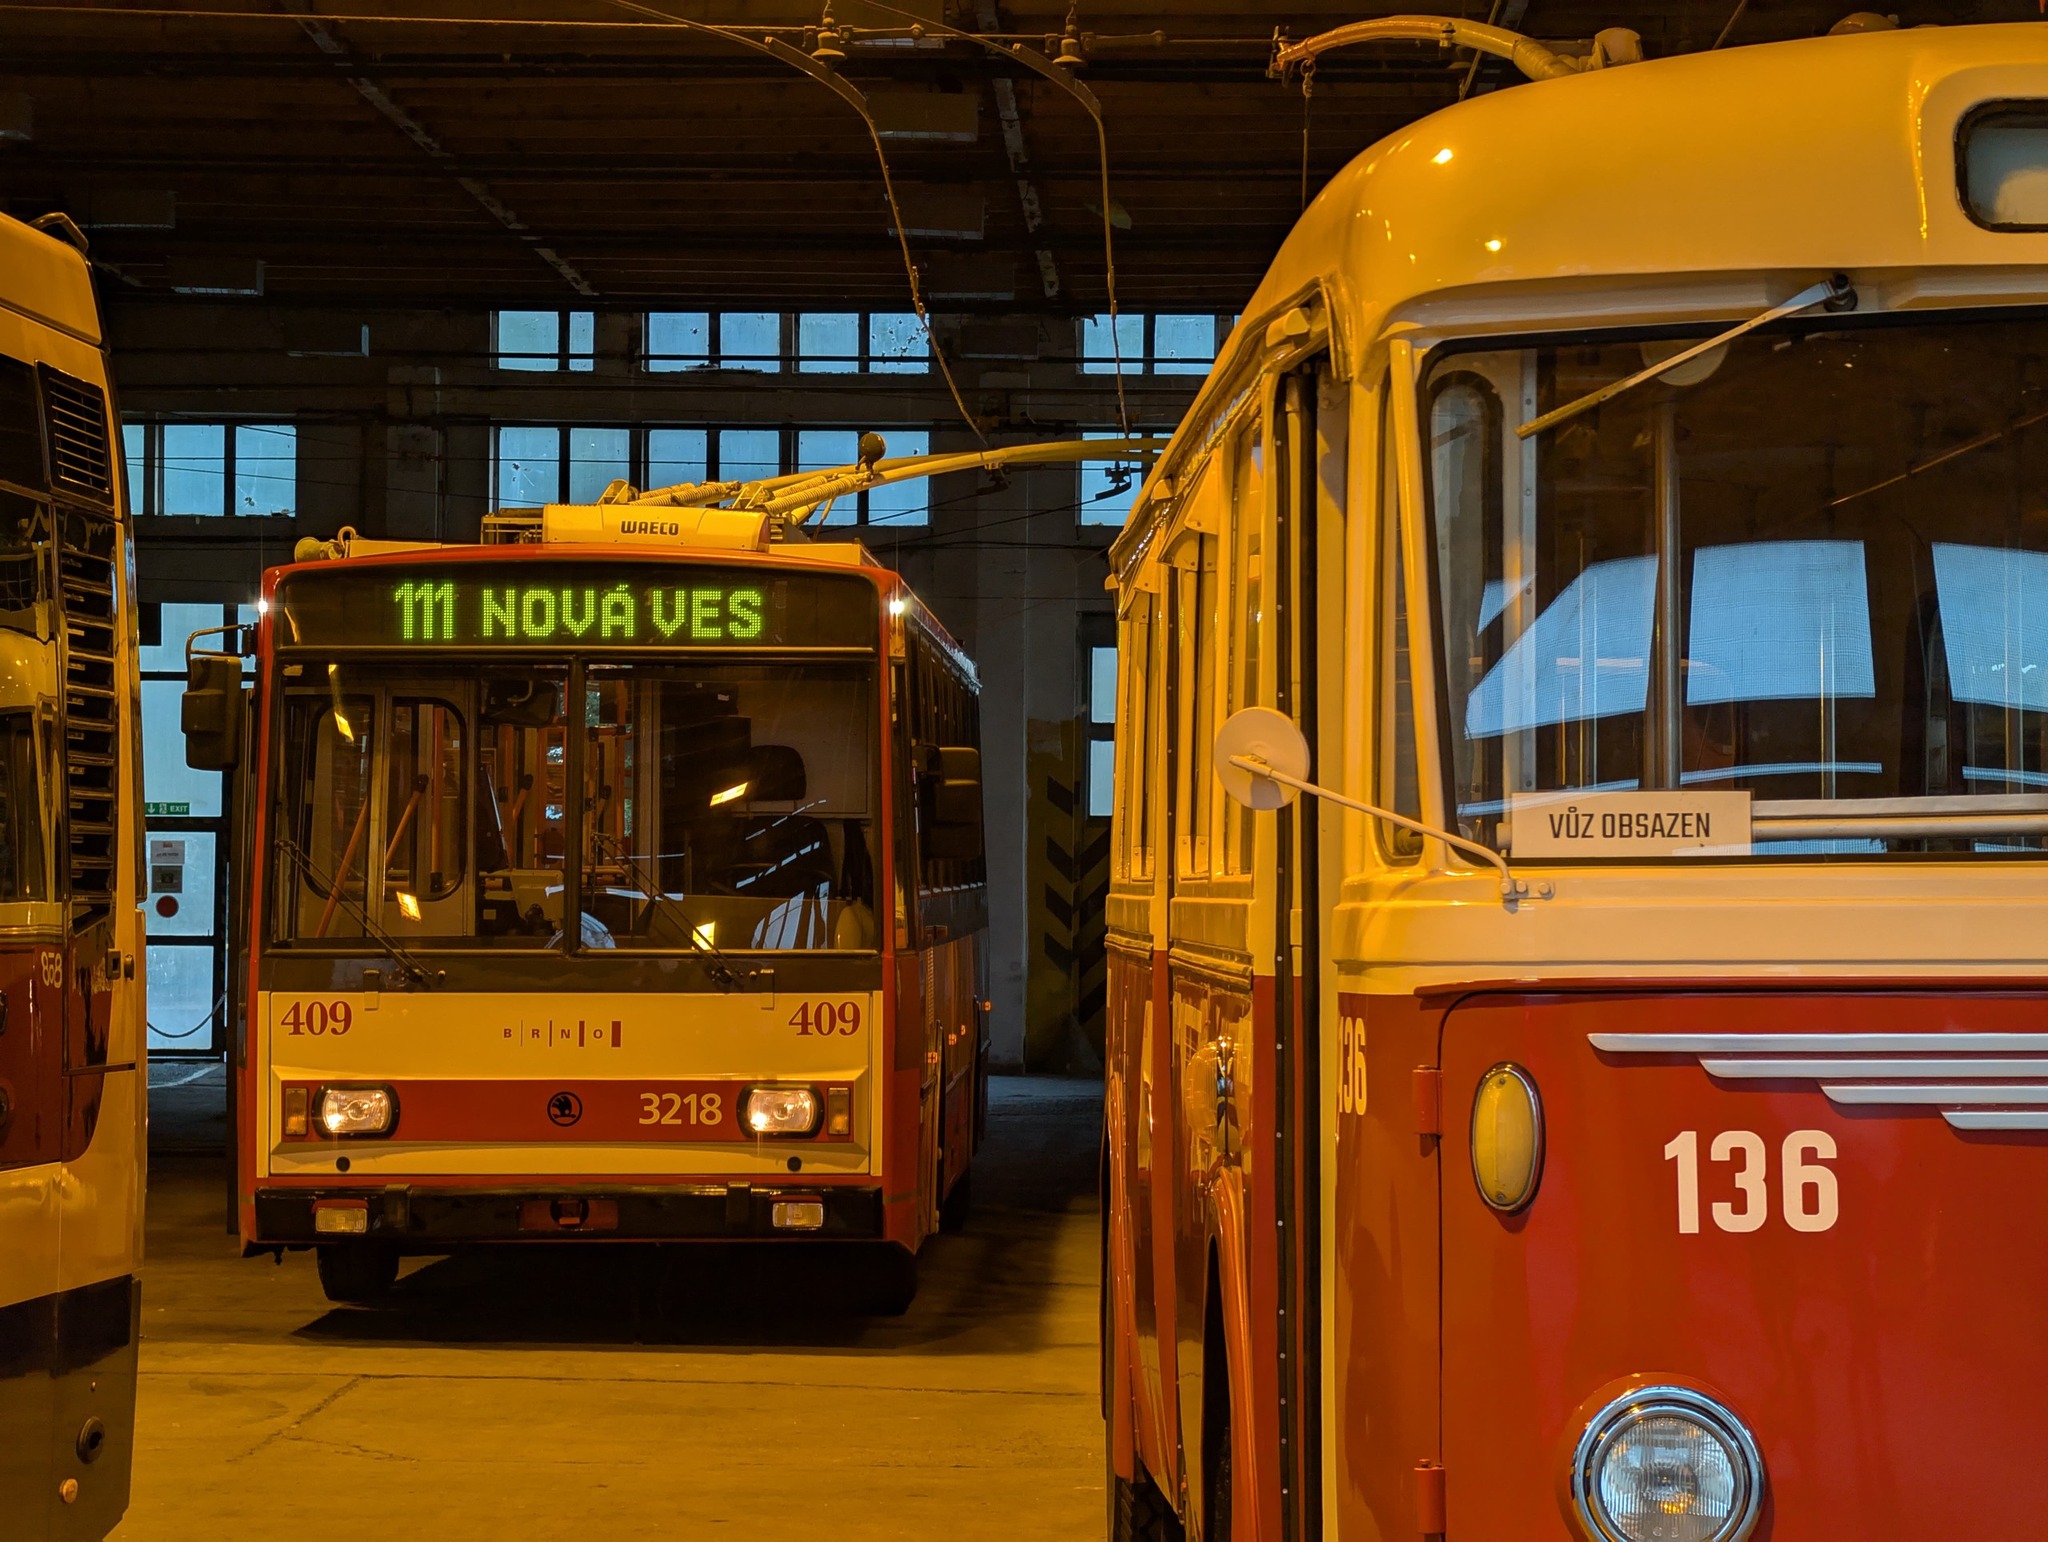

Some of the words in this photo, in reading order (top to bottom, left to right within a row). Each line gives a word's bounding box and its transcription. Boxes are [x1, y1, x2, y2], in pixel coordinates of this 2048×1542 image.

[621, 521, 679, 536] WAECO
[395, 583, 453, 639] 111
[483, 584, 634, 638] NOVÁ
[652, 590, 761, 638] VES
[1549, 806, 1595, 838] VŮZ
[1602, 812, 1710, 838] OBSAZEN
[280, 1001, 352, 1036] 409
[788, 1001, 861, 1036] 409
[1338, 1016, 1368, 1116] 136
[638, 1092, 723, 1126] 3218
[1664, 1129, 1839, 1234] 136
